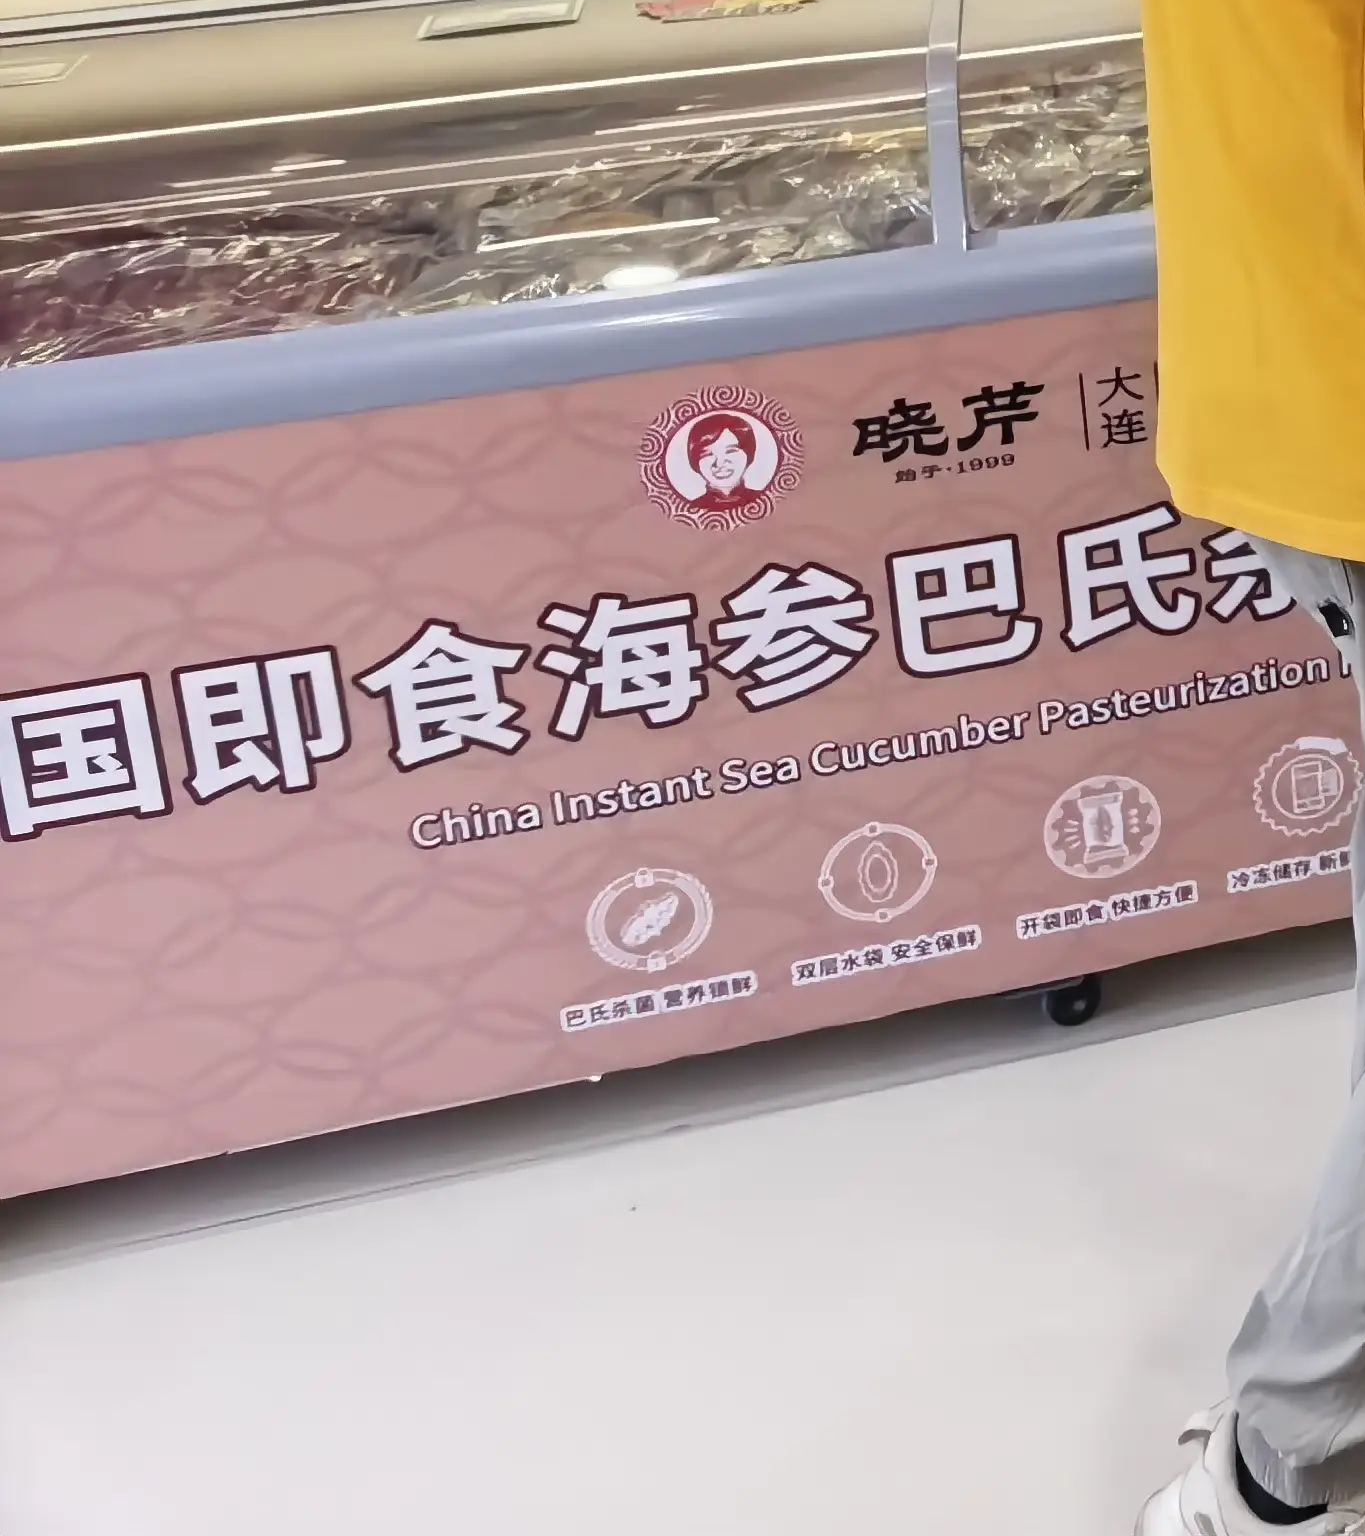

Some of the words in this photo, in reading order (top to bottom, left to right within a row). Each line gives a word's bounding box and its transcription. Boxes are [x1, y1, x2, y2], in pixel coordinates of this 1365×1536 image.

[852, 380, 1045, 463] 晓芹
[1096, 366, 1148, 449] 大连
[411, 803, 543, 850] China
[550, 766, 714, 826] Instant
[719, 754, 802, 795] Sea
[809, 709, 1031, 776] Cucumber
[1038, 653, 1331, 737] Pasteurization
[1230, 859, 1312, 889] 冷冻储存
[1020, 903, 1105, 938] 开袋即食
[1111, 883, 1195, 917] 快捷方便
[795, 947, 884, 982] 双层水袋
[891, 929, 977, 963] 安全保鲜
